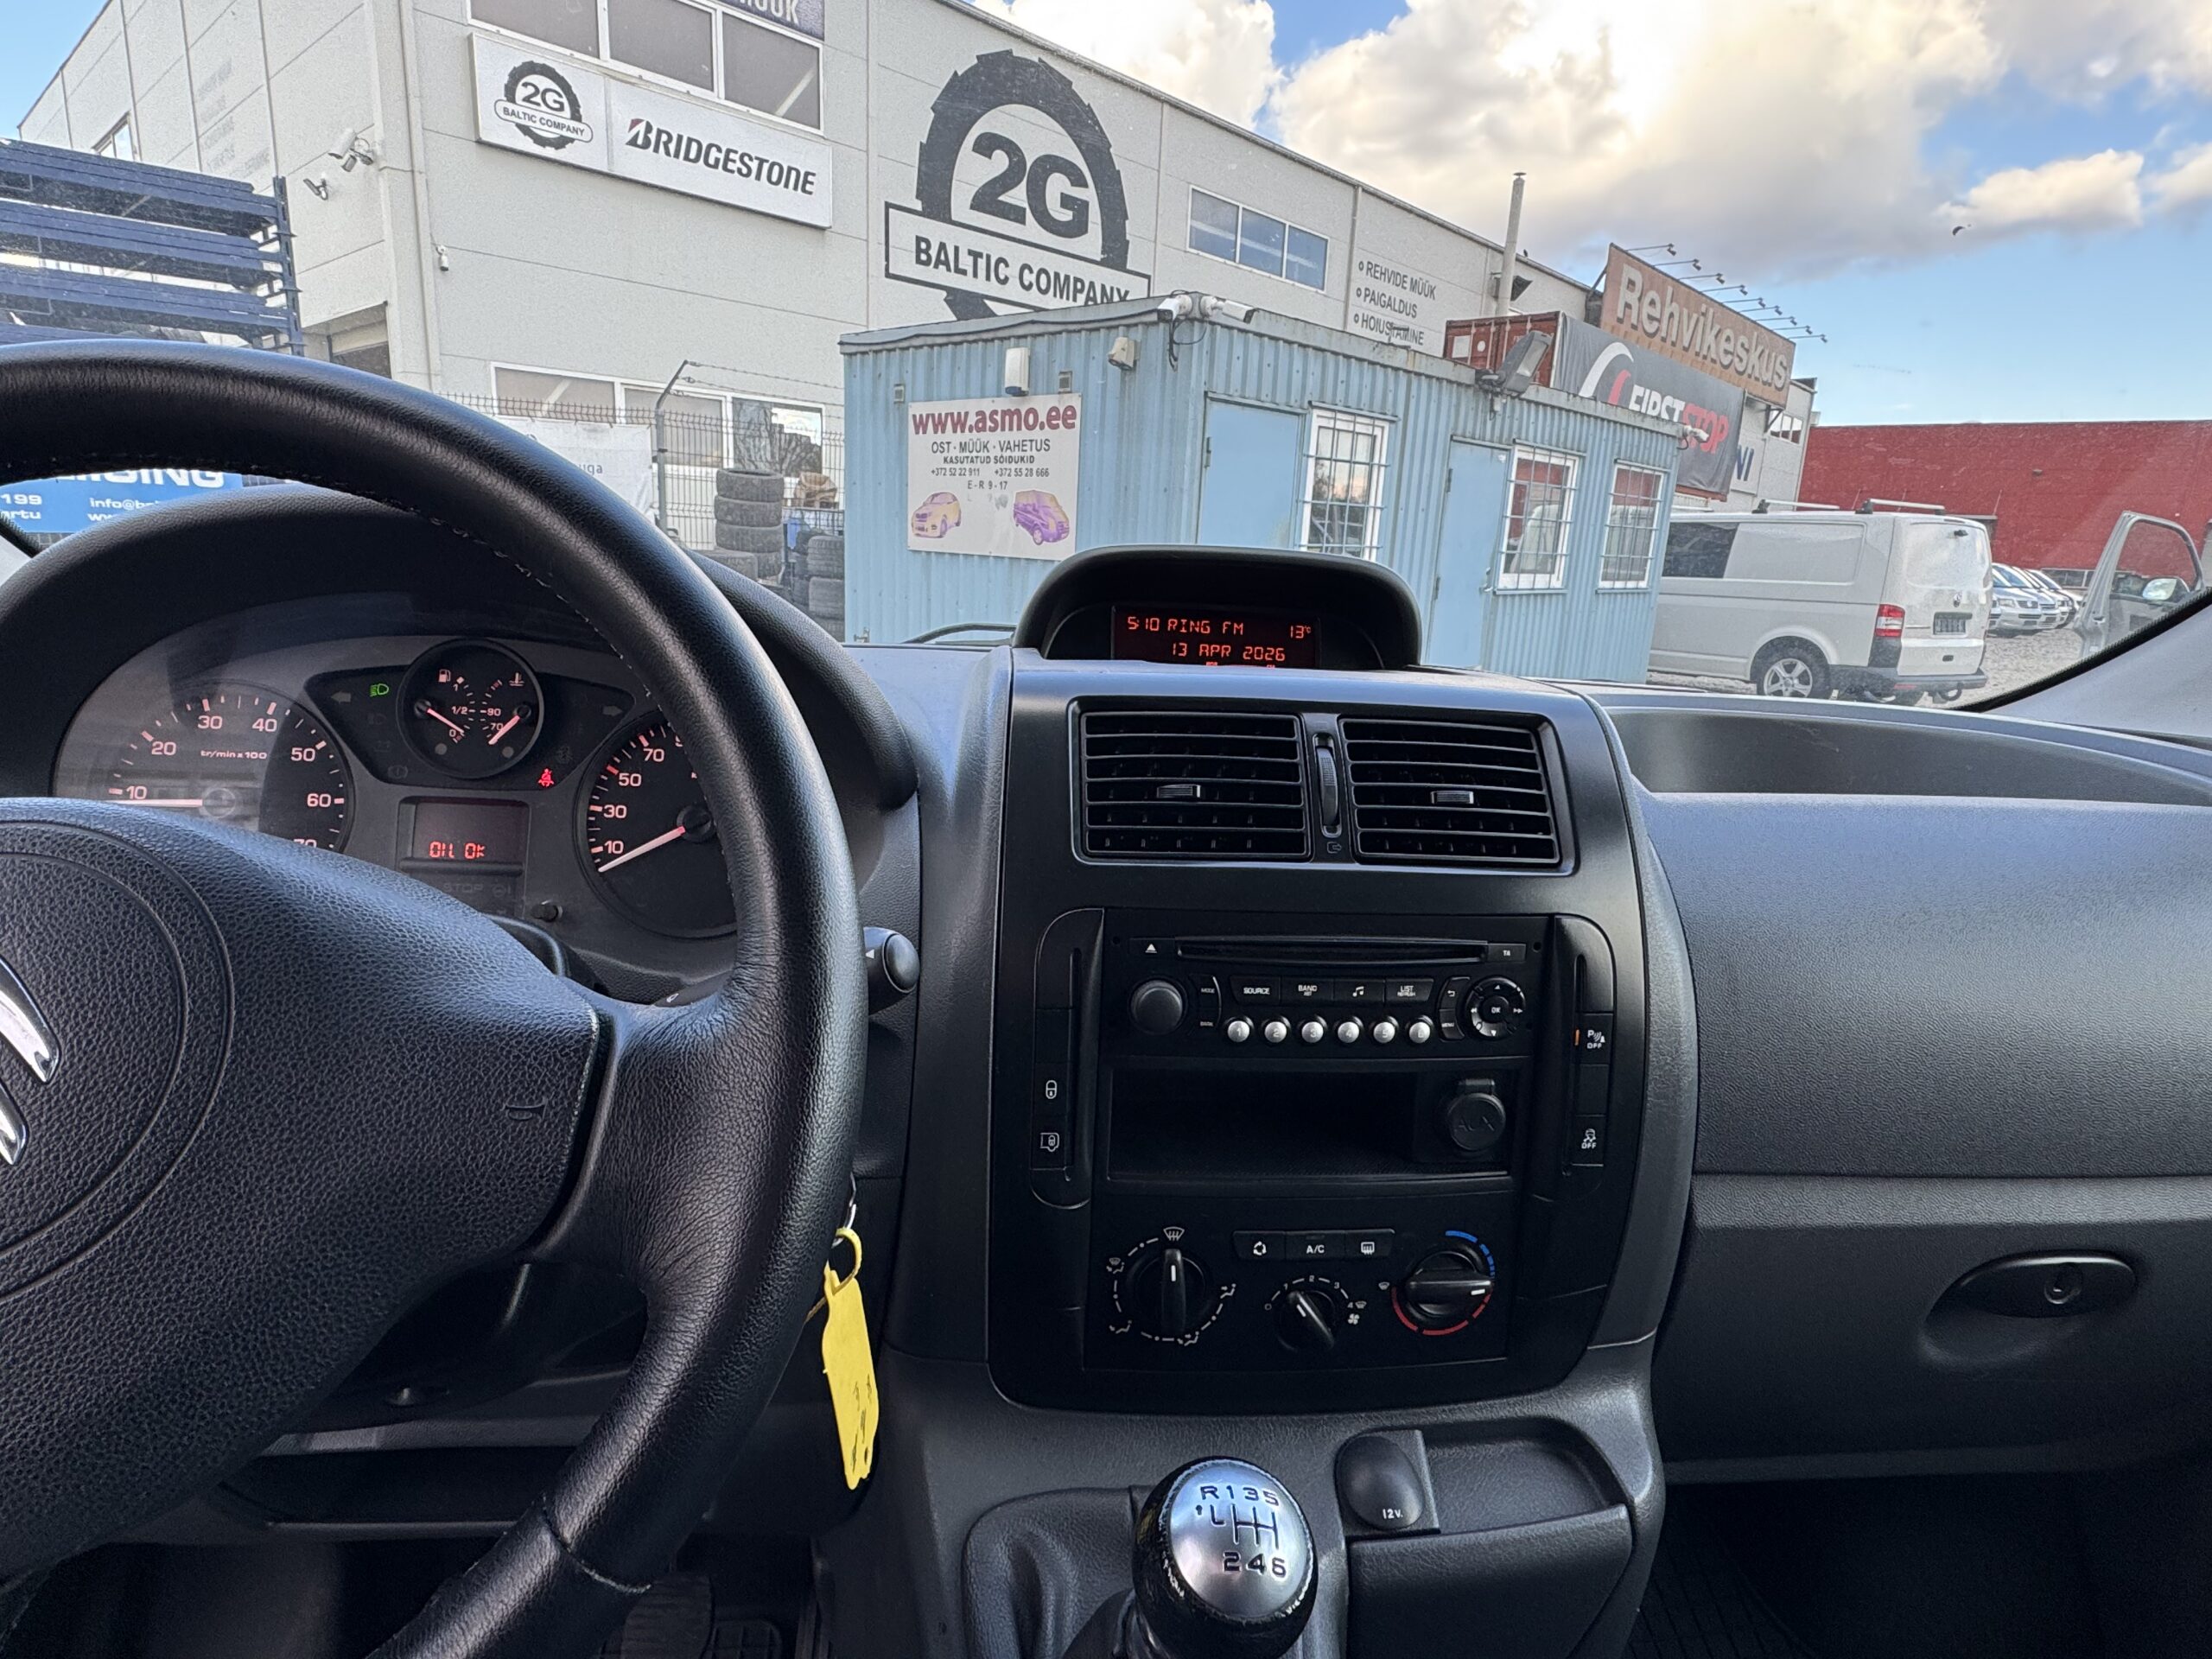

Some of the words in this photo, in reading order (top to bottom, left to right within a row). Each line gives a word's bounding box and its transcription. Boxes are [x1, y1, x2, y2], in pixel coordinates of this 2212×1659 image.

[521, 81, 565, 112] 2G
[503, 106, 537, 124] BALTIC
[539, 117, 585, 137] COMPANY
[626, 118, 817, 196] BRIDGESTONE
[969, 131, 1090, 238] 2G
[915, 235, 1009, 285] BALTIC
[1366, 261, 1408, 290] REHVIDE
[1410, 276, 1436, 301] MÜÜK
[1363, 287, 1418, 319] PAIGALDUS
[1617, 264, 1789, 391] Rehvikeskus
[912, 405, 1077, 435] www.asmo.ee
[931, 442, 952, 454] OST
[959, 438, 989, 454] MÜÜK
[998, 438, 1051, 453] VAHETUS
[944, 455, 991, 464] KASUTATUD
[1167, 619, 1211, 634] RING
[1223, 621, 1244, 635] FM
[1173, 642, 1187, 657] 13
[1198, 644, 1231, 658] APR
[1243, 646, 1286, 662] 2026
[197, 715, 223, 729] 30
[251, 718, 278, 733] 40
[151, 741, 176, 756] 20
[290, 747, 316, 762] 50
[643, 748, 664, 762] 70
[618, 772, 642, 786] 50
[125, 785, 148, 800] 10
[307, 792, 332, 807] 60
[603, 804, 627, 818] 30
[604, 840, 624, 854] 10
[1306, 1245, 1325, 1254] A/C
